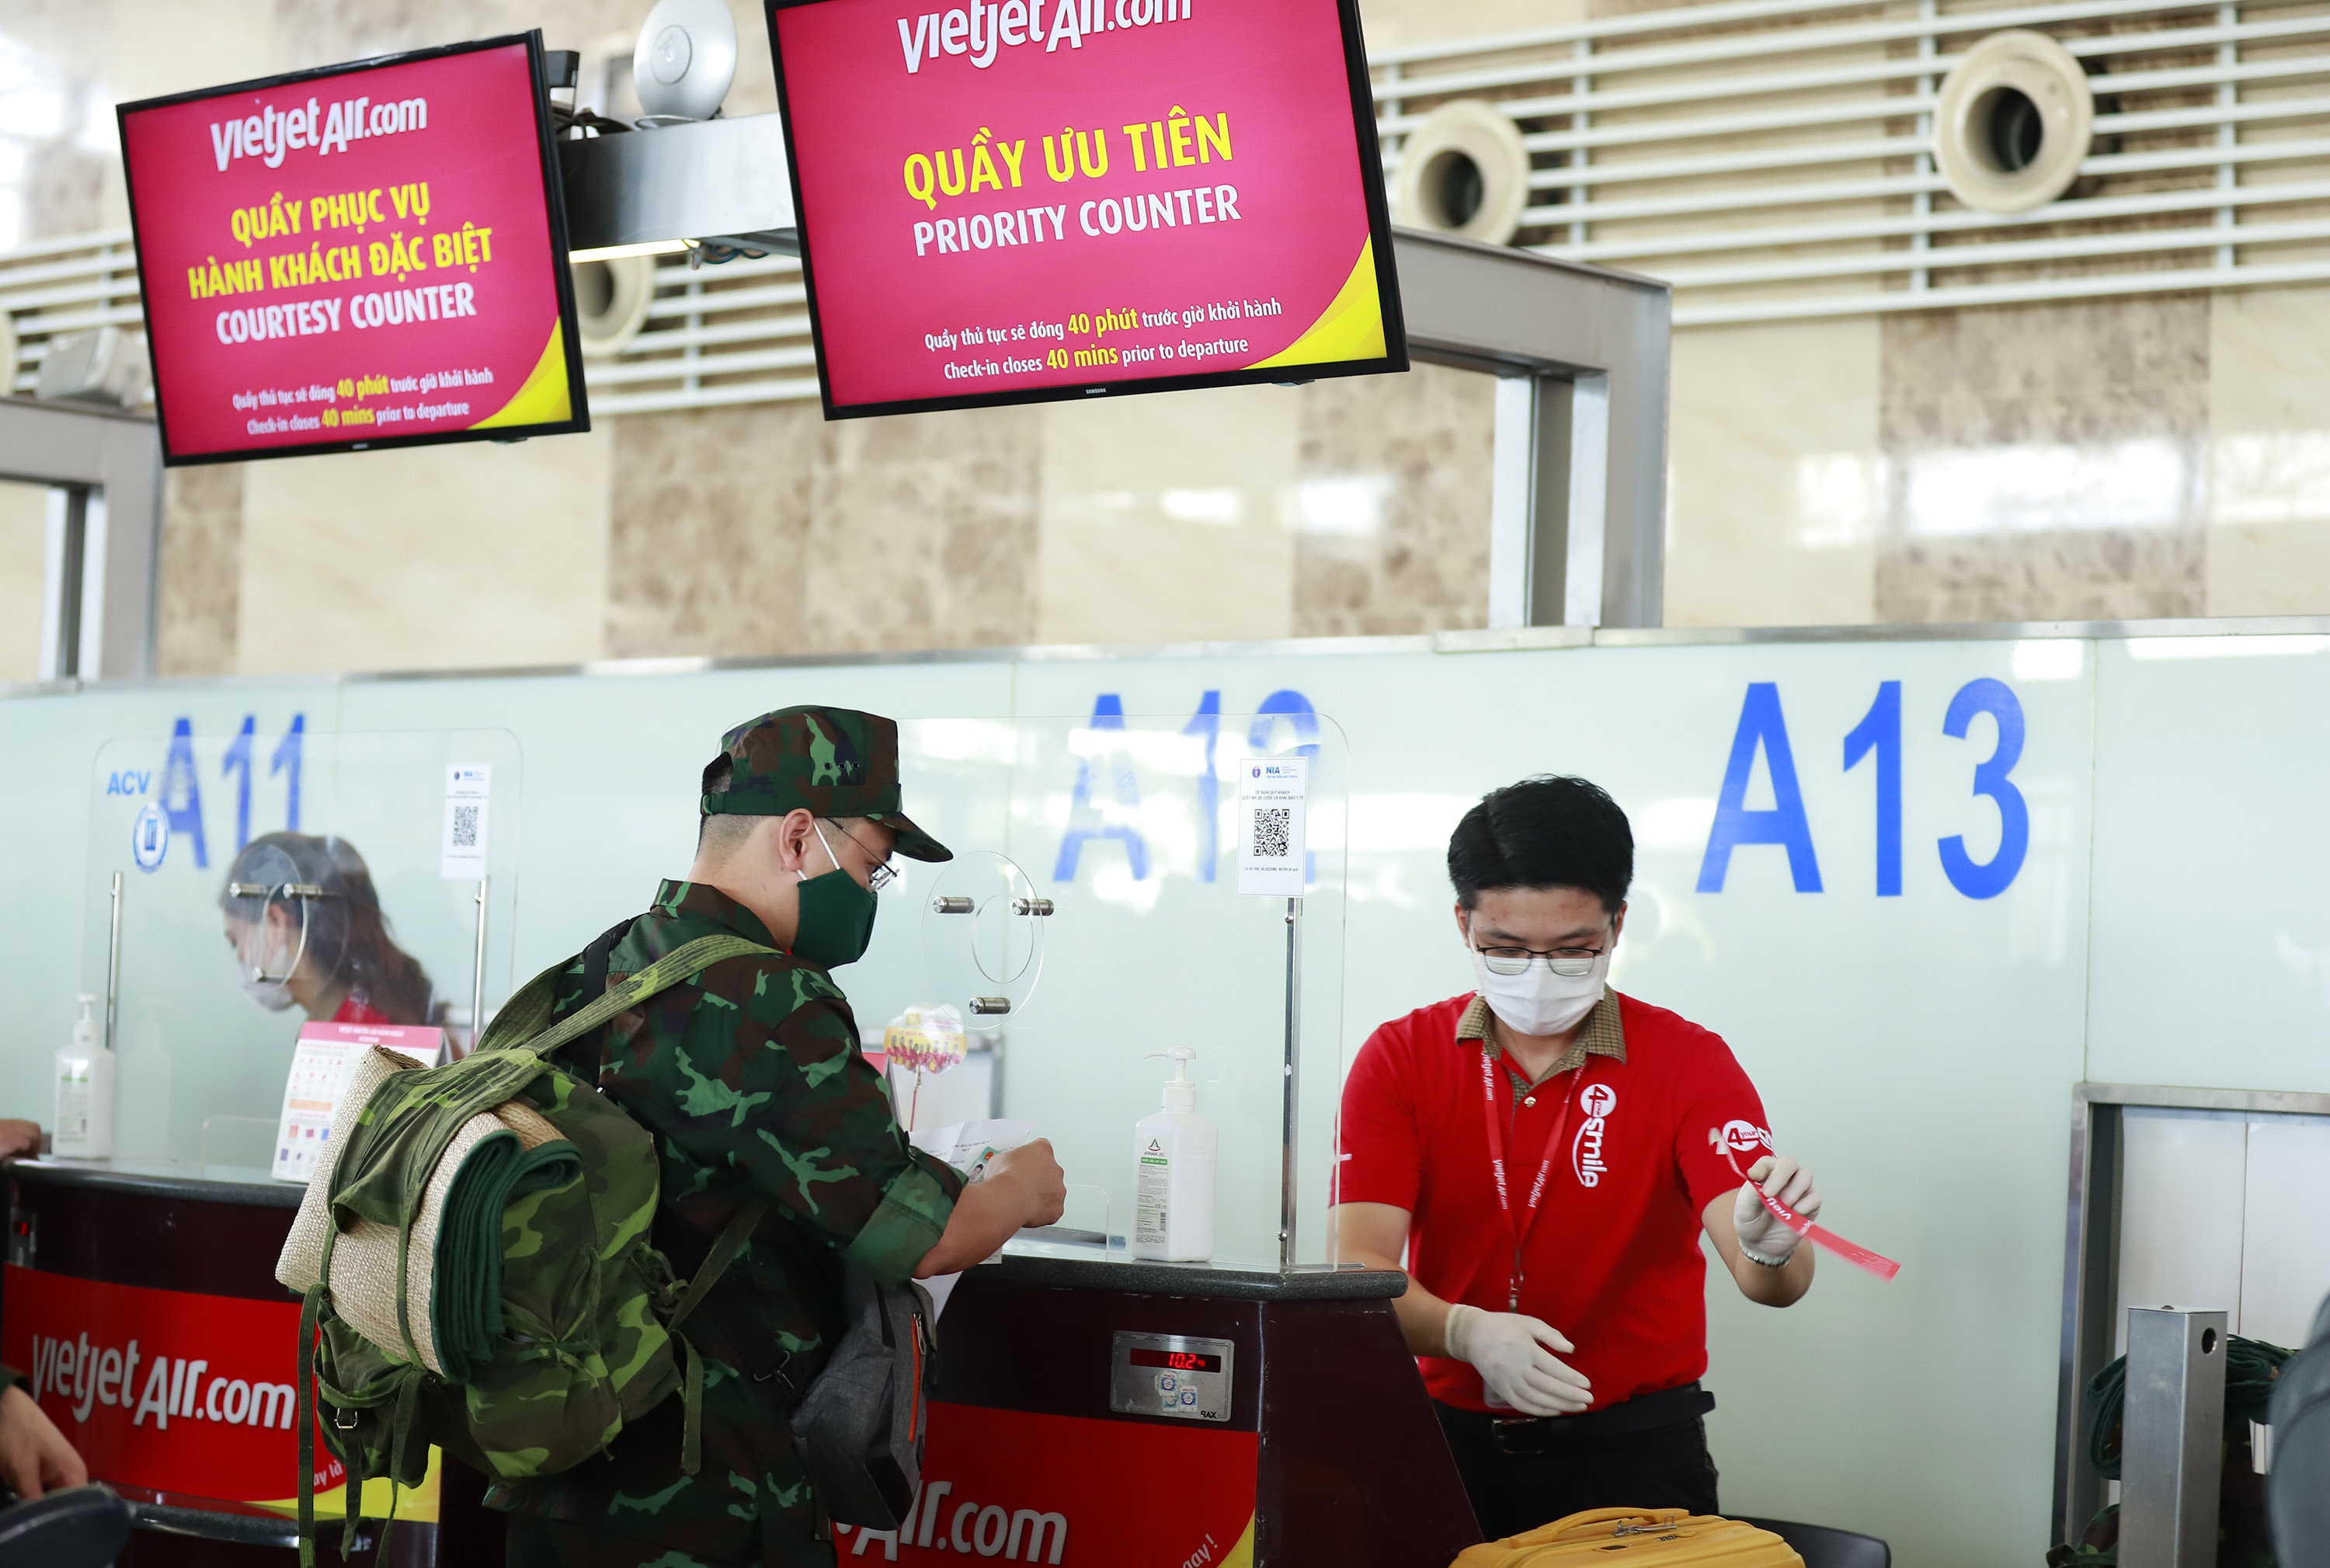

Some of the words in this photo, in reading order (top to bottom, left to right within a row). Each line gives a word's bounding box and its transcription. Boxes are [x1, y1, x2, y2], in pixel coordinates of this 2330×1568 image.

[903, 127, 1027, 210] QUẦY
[1042, 127, 1109, 183] ƯU
[1122, 104, 1233, 172] TIÊN
[231, 191, 302, 248] QUẦY
[310, 188, 385, 235] PHỤC
[389, 182, 431, 226] VỤ
[913, 204, 1067, 257] PRIORITY
[1079, 184, 1242, 236] COUNTER
[187, 256, 264, 300] HÀNH
[270, 241, 363, 289] KHÁCH
[368, 231, 427, 283] ĐẶC
[432, 221, 492, 273] BIỆT
[216, 297, 342, 345] COURTESY
[350, 281, 477, 329] COUNTER
[924, 330, 958, 351] Quầy
[960, 325, 983, 347] thủ
[986, 326, 1008, 344] tục
[1010, 323, 1026, 341] sẽ
[1030, 321, 1064, 339] đóng
[1067, 314, 1090, 334] 40
[1095, 308, 1139, 337] phút
[1141, 310, 1179, 329] trước
[1181, 305, 1205, 328] giờ
[1208, 301, 1240, 322] khởi
[1243, 297, 1282, 318] hành
[944, 355, 1000, 380] Check-in
[1002, 350, 1042, 374] closes
[1045, 348, 1069, 370] 40
[1073, 343, 1119, 366] mins
[1122, 346, 1156, 367] prior
[1159, 344, 1174, 360] to
[1177, 338, 1249, 360] departure
[336, 379, 354, 398] 40
[356, 374, 390, 401] phút
[247, 416, 289, 435] Check-in
[290, 414, 320, 431] closes
[321, 409, 339, 427] 40
[340, 405, 375, 426] mins
[376, 407, 402, 426] prior
[402, 405, 416, 419] to
[416, 402, 469, 419] departure
[106, 770, 151, 796] ACV
[158, 714, 305, 868] A11
[1266, 766, 1281, 774] NIA
[1695, 676, 2030, 901] A13
[1168, 1352, 1197, 1369] 10.2
[314, 1469, 327, 1487] ay
